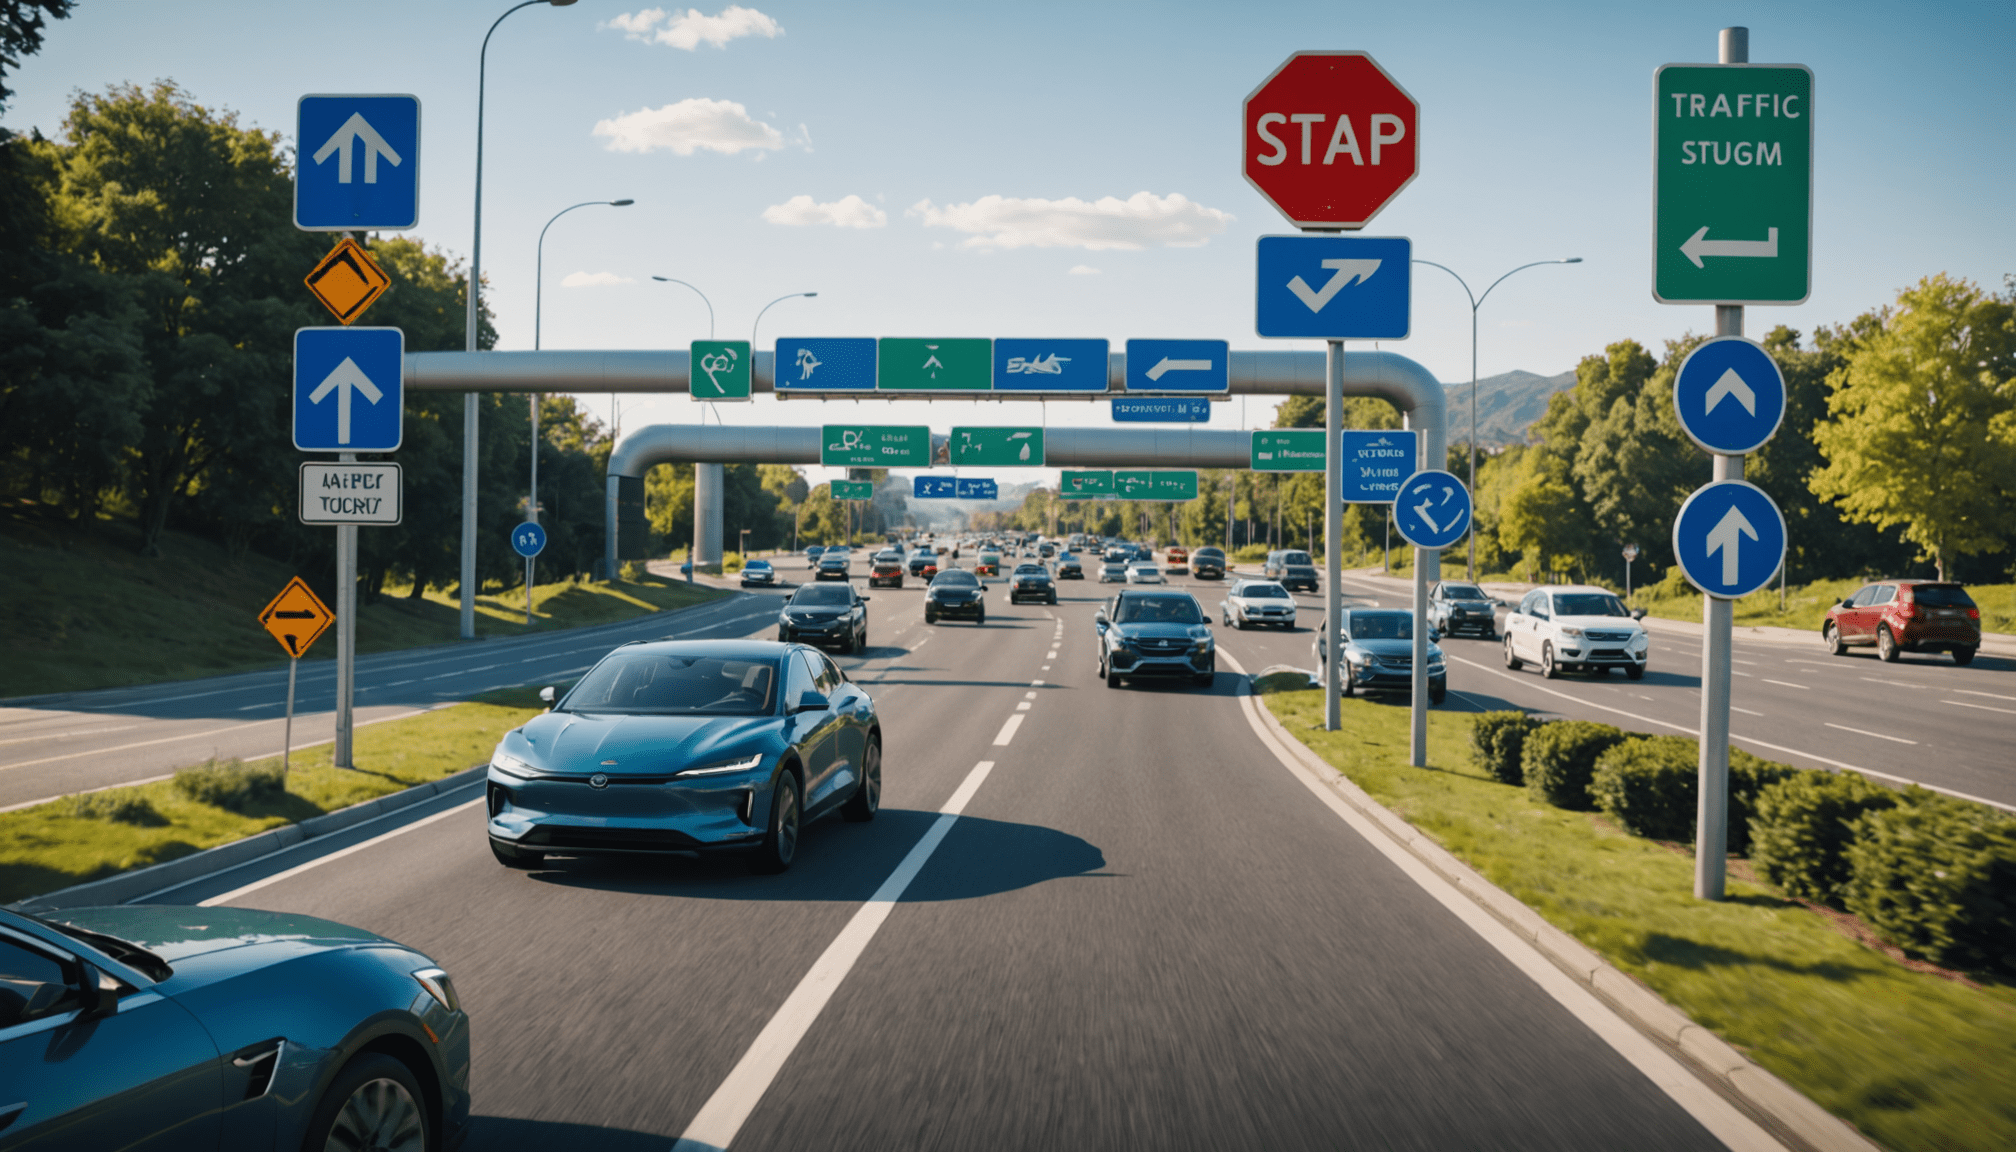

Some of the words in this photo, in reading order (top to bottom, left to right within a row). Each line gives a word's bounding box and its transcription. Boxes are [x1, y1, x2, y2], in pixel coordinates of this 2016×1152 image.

[1671, 93, 1801, 119] TRAFFIC
[1256, 112, 1406, 166] STAP
[1681, 140, 1783, 166] STUGM
